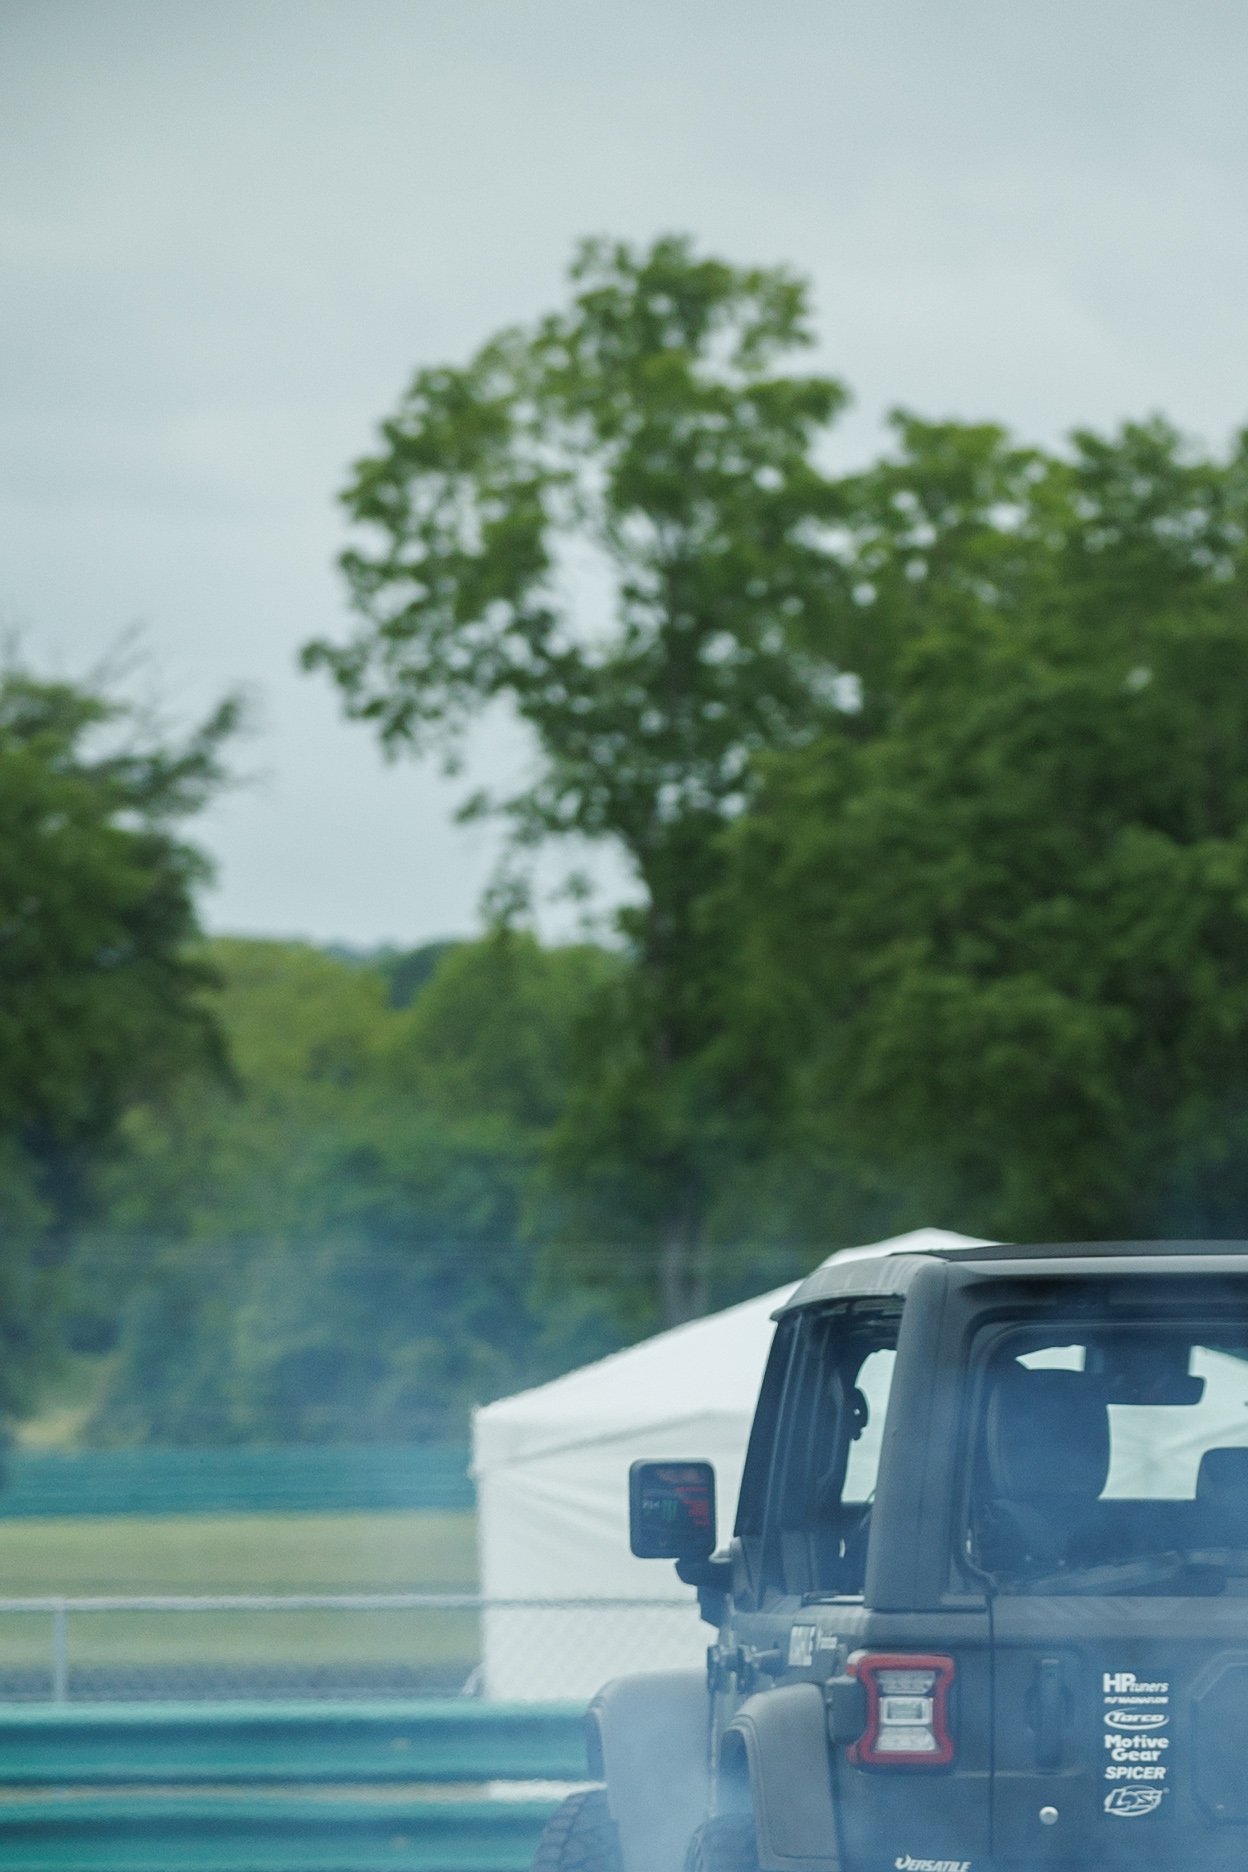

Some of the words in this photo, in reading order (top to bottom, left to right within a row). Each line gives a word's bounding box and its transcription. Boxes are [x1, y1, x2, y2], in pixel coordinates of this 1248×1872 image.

[1104, 1734, 1169, 1749] Motive
[1111, 1748, 1162, 1762] Gear
[1104, 1766, 1167, 1780] SPICER
